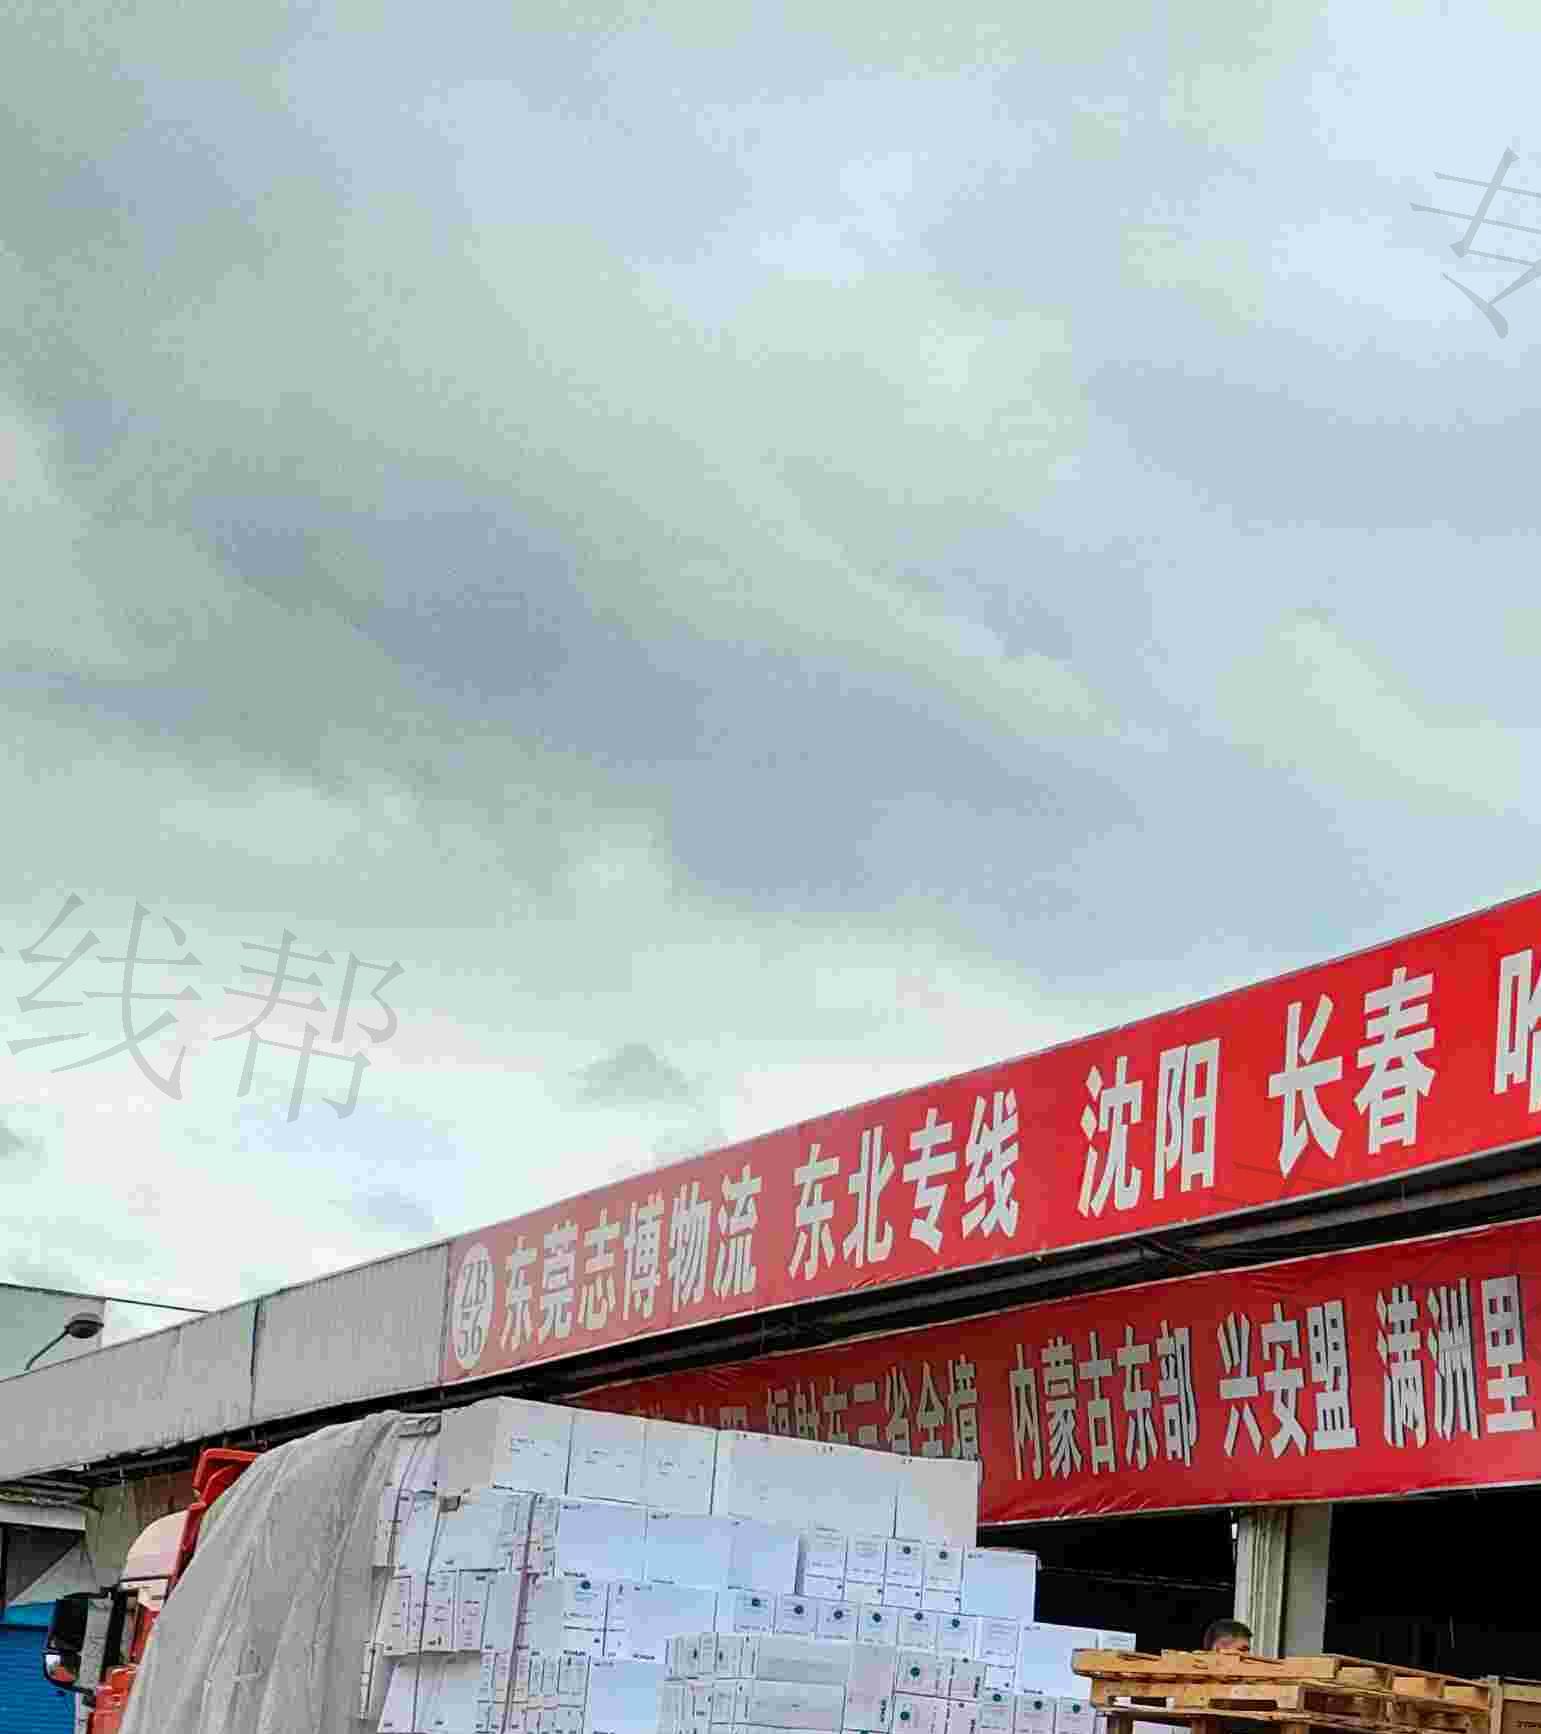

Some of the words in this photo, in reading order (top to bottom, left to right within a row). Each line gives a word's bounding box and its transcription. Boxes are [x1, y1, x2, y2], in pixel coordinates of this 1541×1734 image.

[500, 1163, 763, 1351] 东莞志博物流
[785, 1089, 1021, 1282] 东北专线
[1077, 1039, 1222, 1219] 沈阳
[1266, 967, 1437, 1178] 长春
[1008, 1319, 1199, 1481] 内蒙古东部
[1217, 1300, 1359, 1458] 兴安盟
[1376, 1274, 1536, 1450] 满洲里
